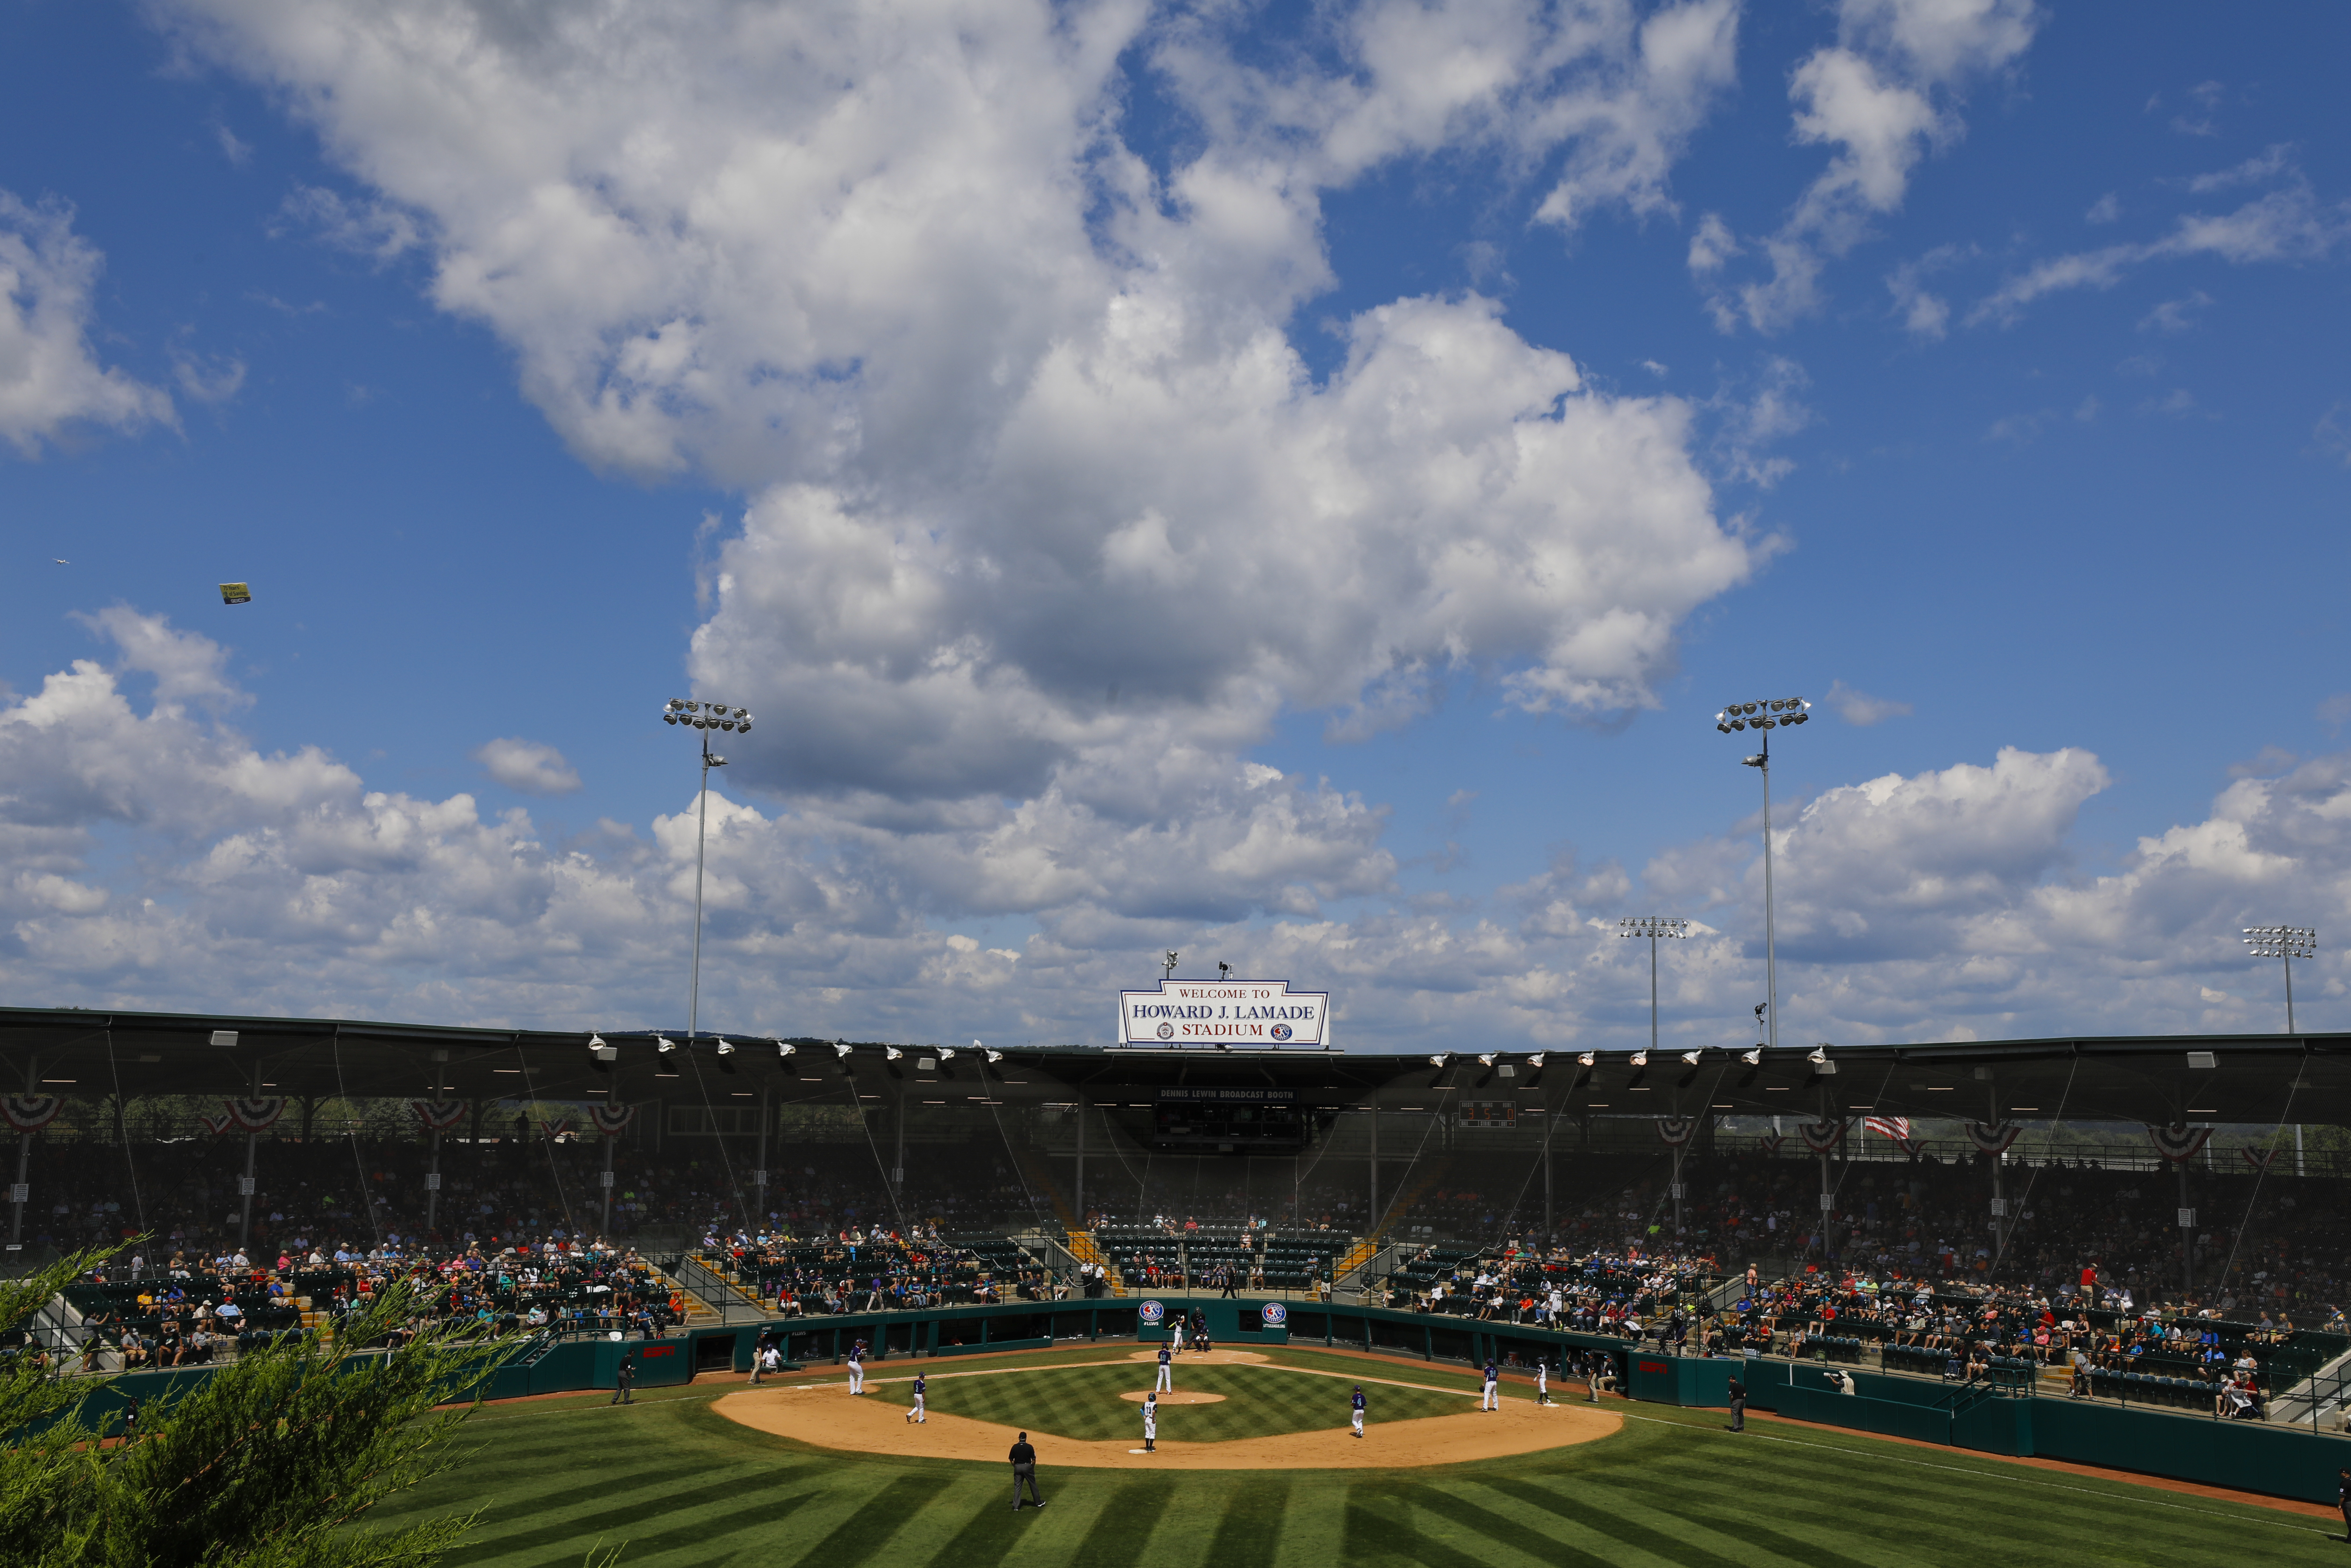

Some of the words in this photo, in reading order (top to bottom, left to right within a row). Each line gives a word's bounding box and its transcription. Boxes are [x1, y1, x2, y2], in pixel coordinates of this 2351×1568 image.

[1179, 989, 1247, 998] WELCOME
[1252, 989, 1270, 999] TO
[1132, 1005, 1212, 1019] HOWARD
[1218, 1006, 1229, 1020] J.
[1234, 1006, 1314, 1020] LAMADE
[1183, 1024, 1263, 1035] STADIUM
[1468, 1108, 1474, 1119] 3
[1484, 1108, 1490, 1120] 5
[1508, 1109, 1514, 1120] 0
[643, 1346, 675, 1358] ESPN
[1639, 1361, 1667, 1374] ESPN
[1357, 1398, 1362, 1406] 4
